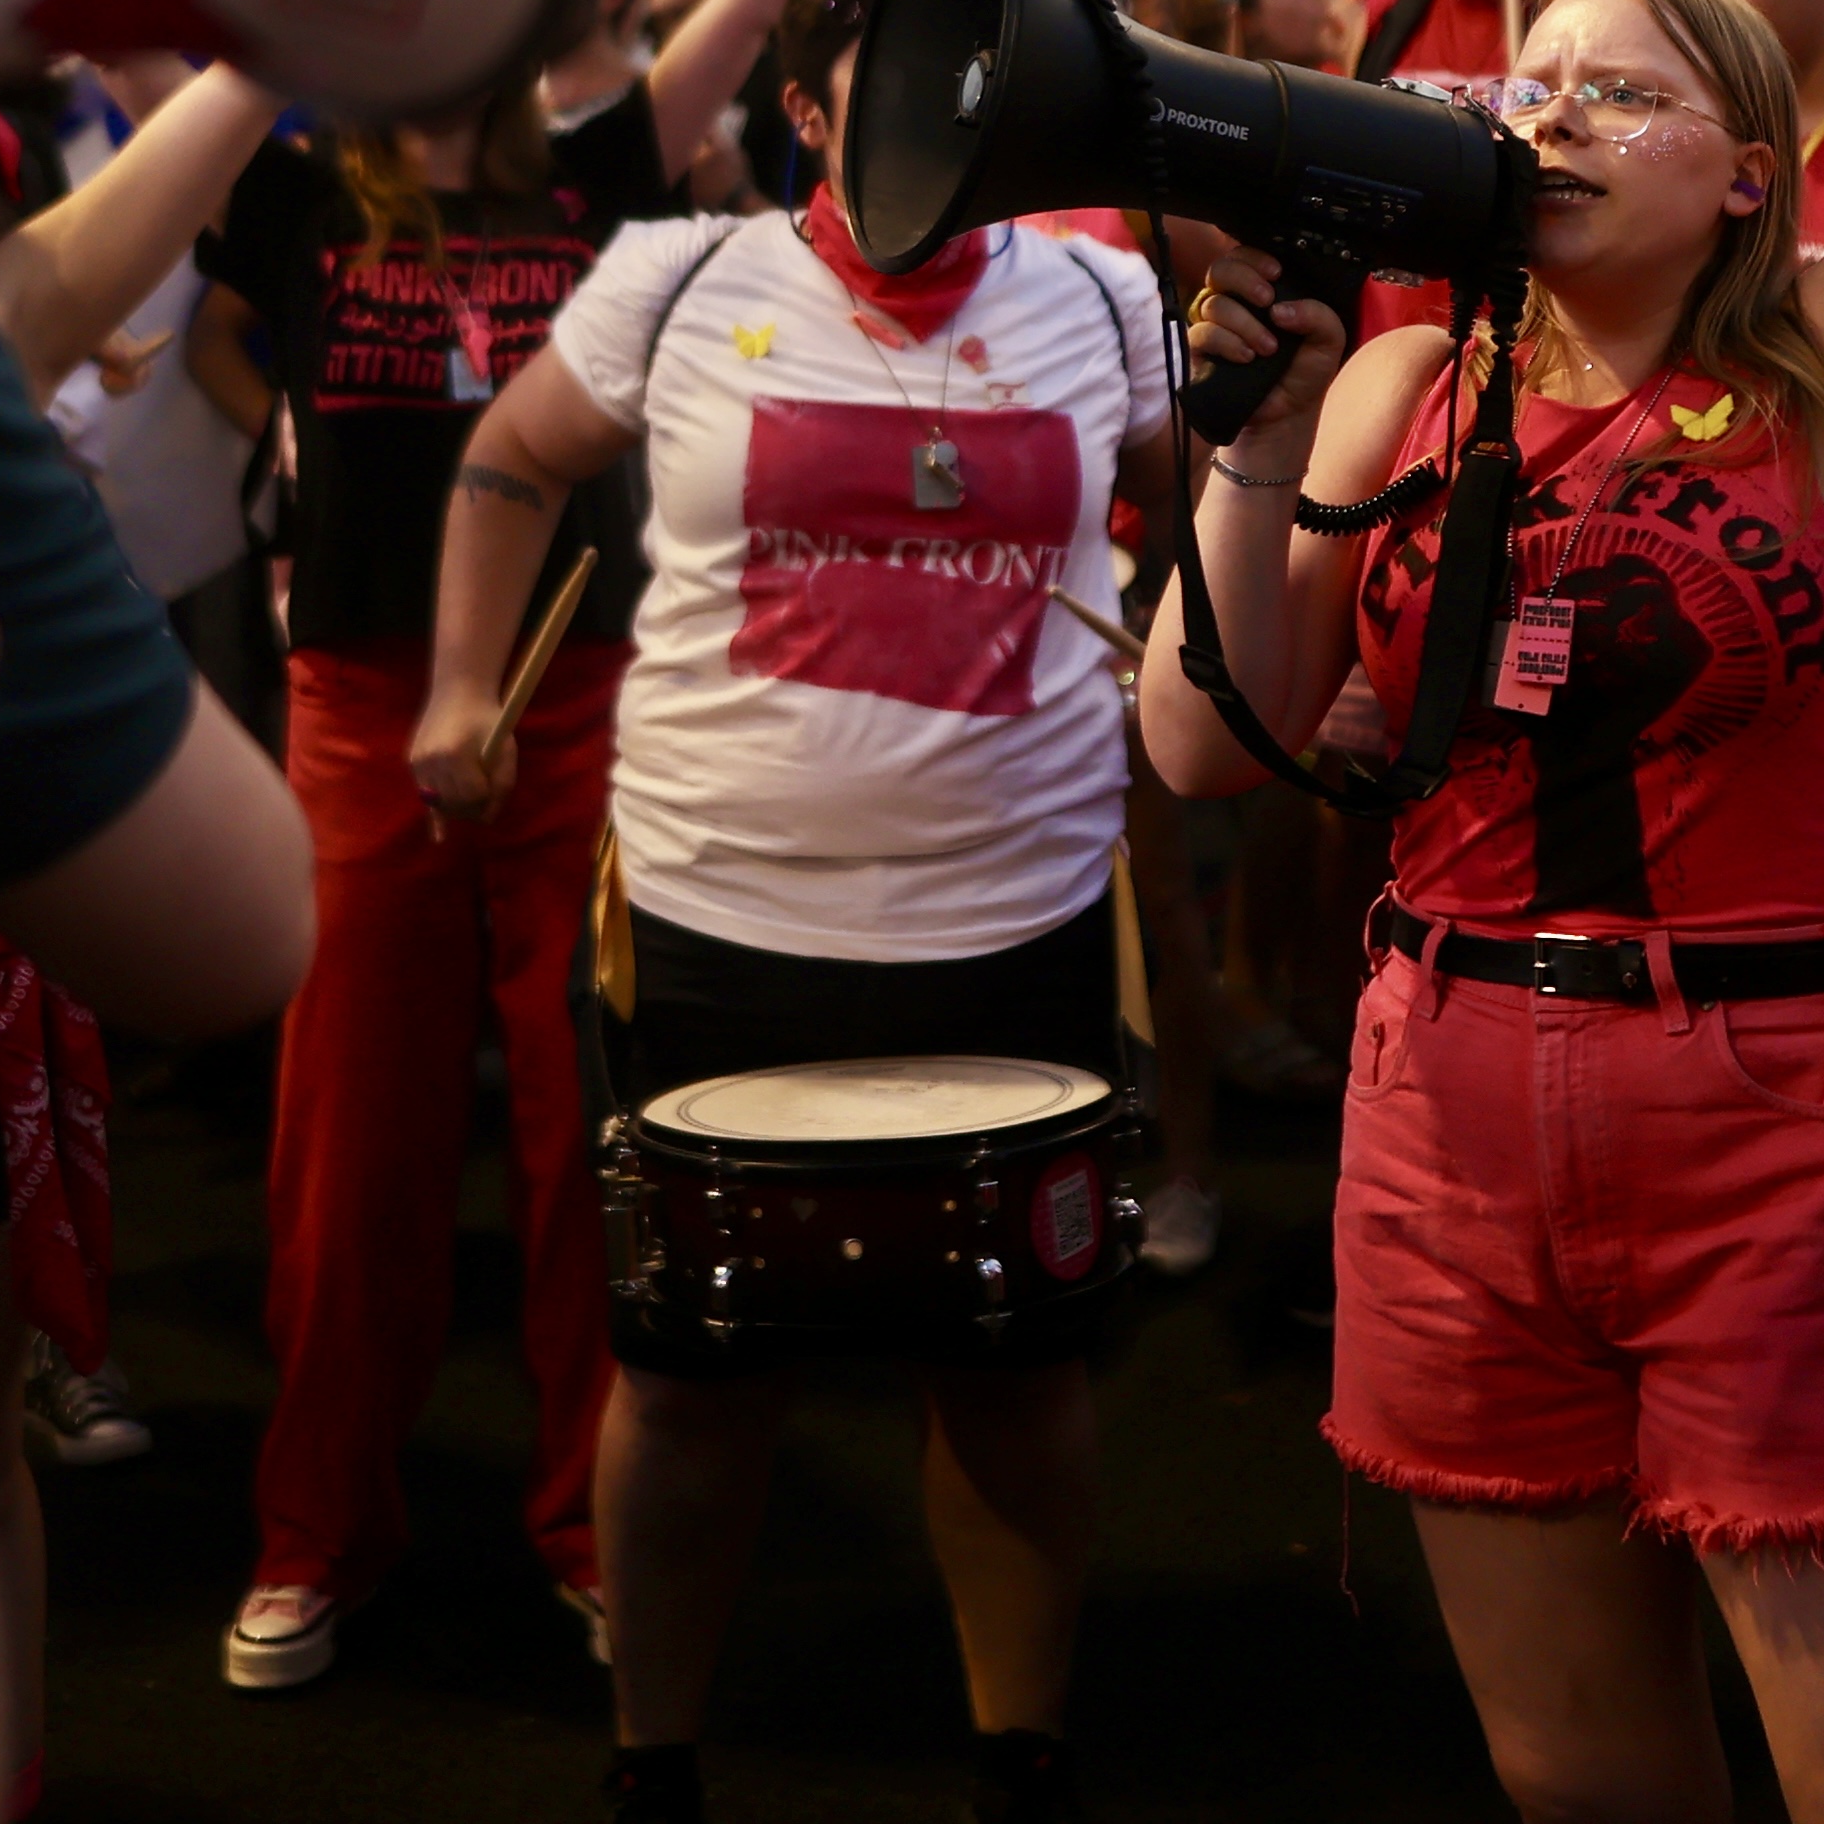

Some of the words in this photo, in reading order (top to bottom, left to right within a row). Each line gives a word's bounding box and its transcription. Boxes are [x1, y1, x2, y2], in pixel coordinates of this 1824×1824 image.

[1166, 107, 1250, 141] PROXTONE
[747, 526, 870, 571] PINK
[887, 536, 1069, 591] FRONT
